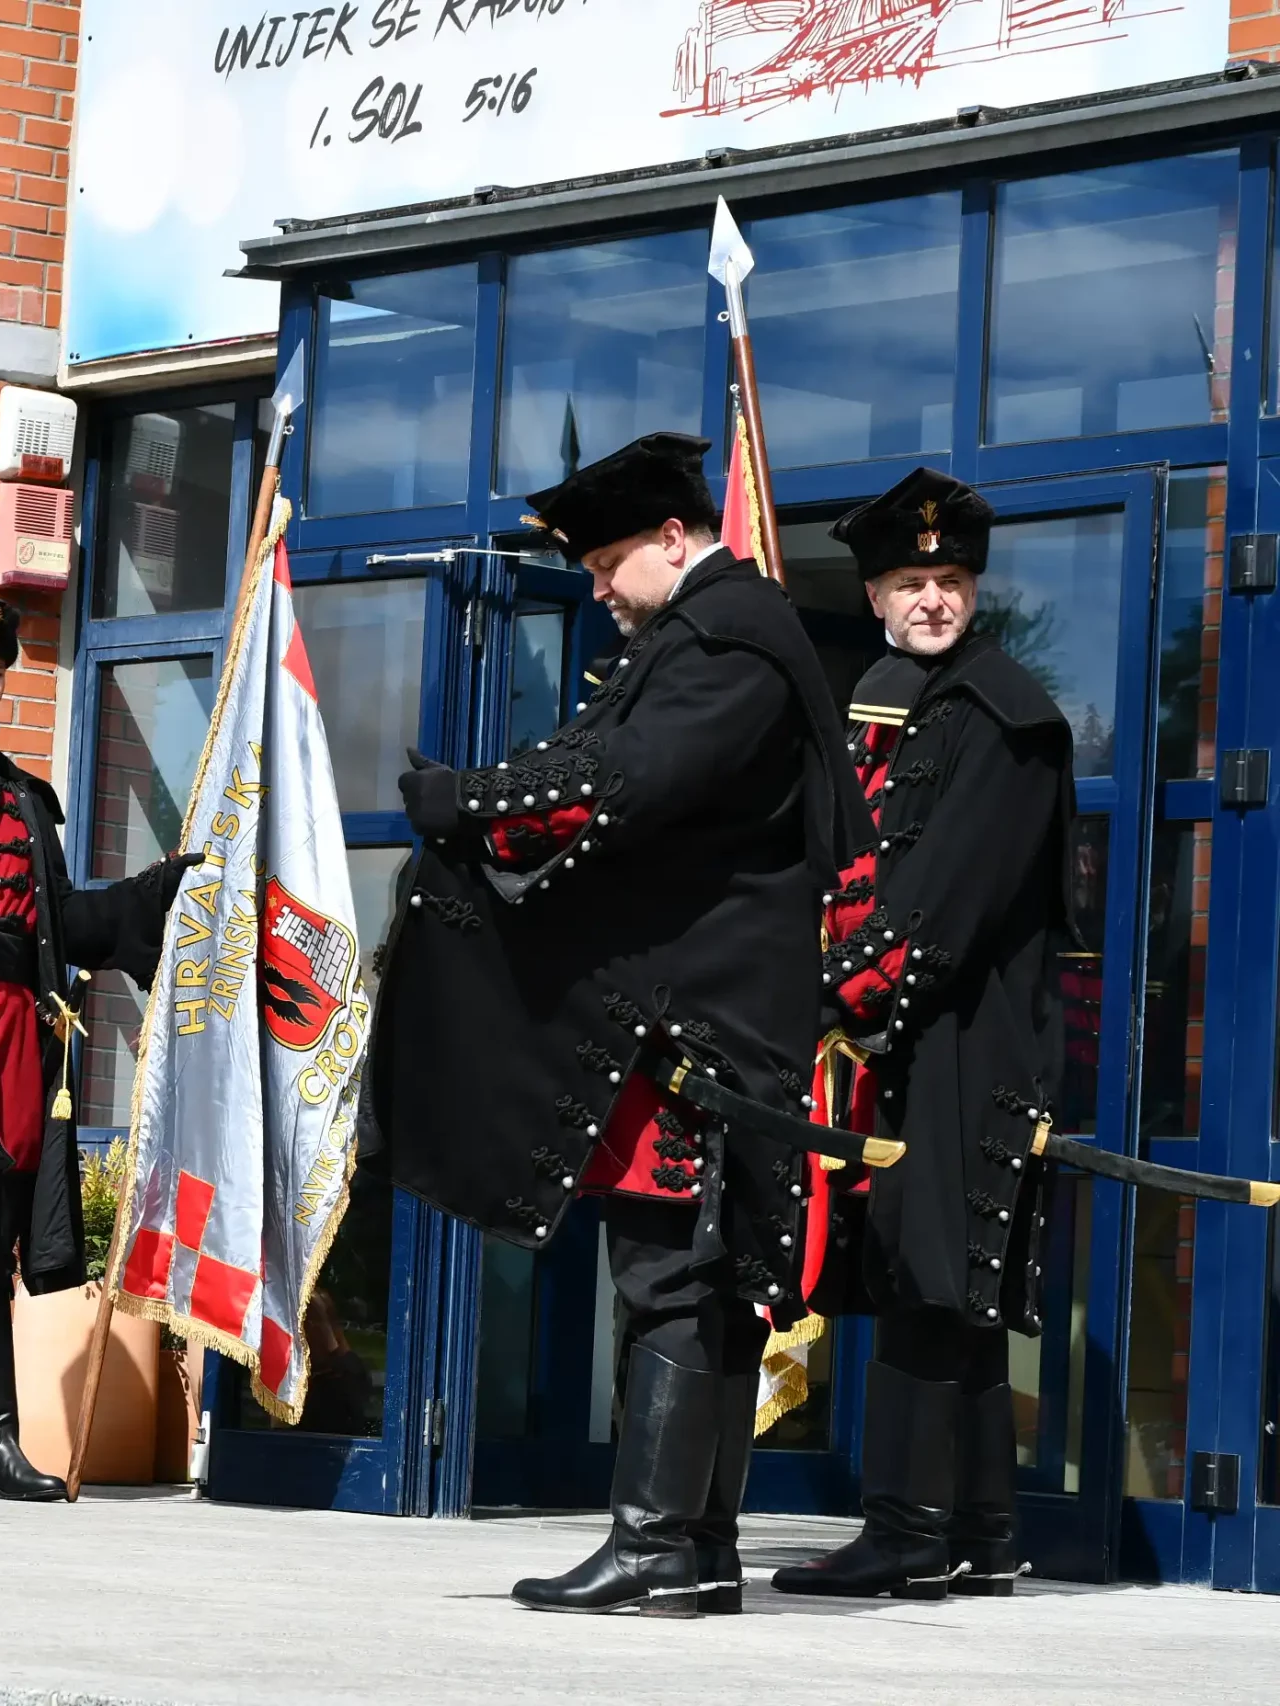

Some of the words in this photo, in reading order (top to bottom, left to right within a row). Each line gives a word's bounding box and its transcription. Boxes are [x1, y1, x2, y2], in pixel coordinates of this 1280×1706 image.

[369, 0, 421, 48] SE
[348, 75, 423, 144] SOL
[462, 67, 538, 122] 5:16
[293, 1149, 340, 1226] NAVIK
